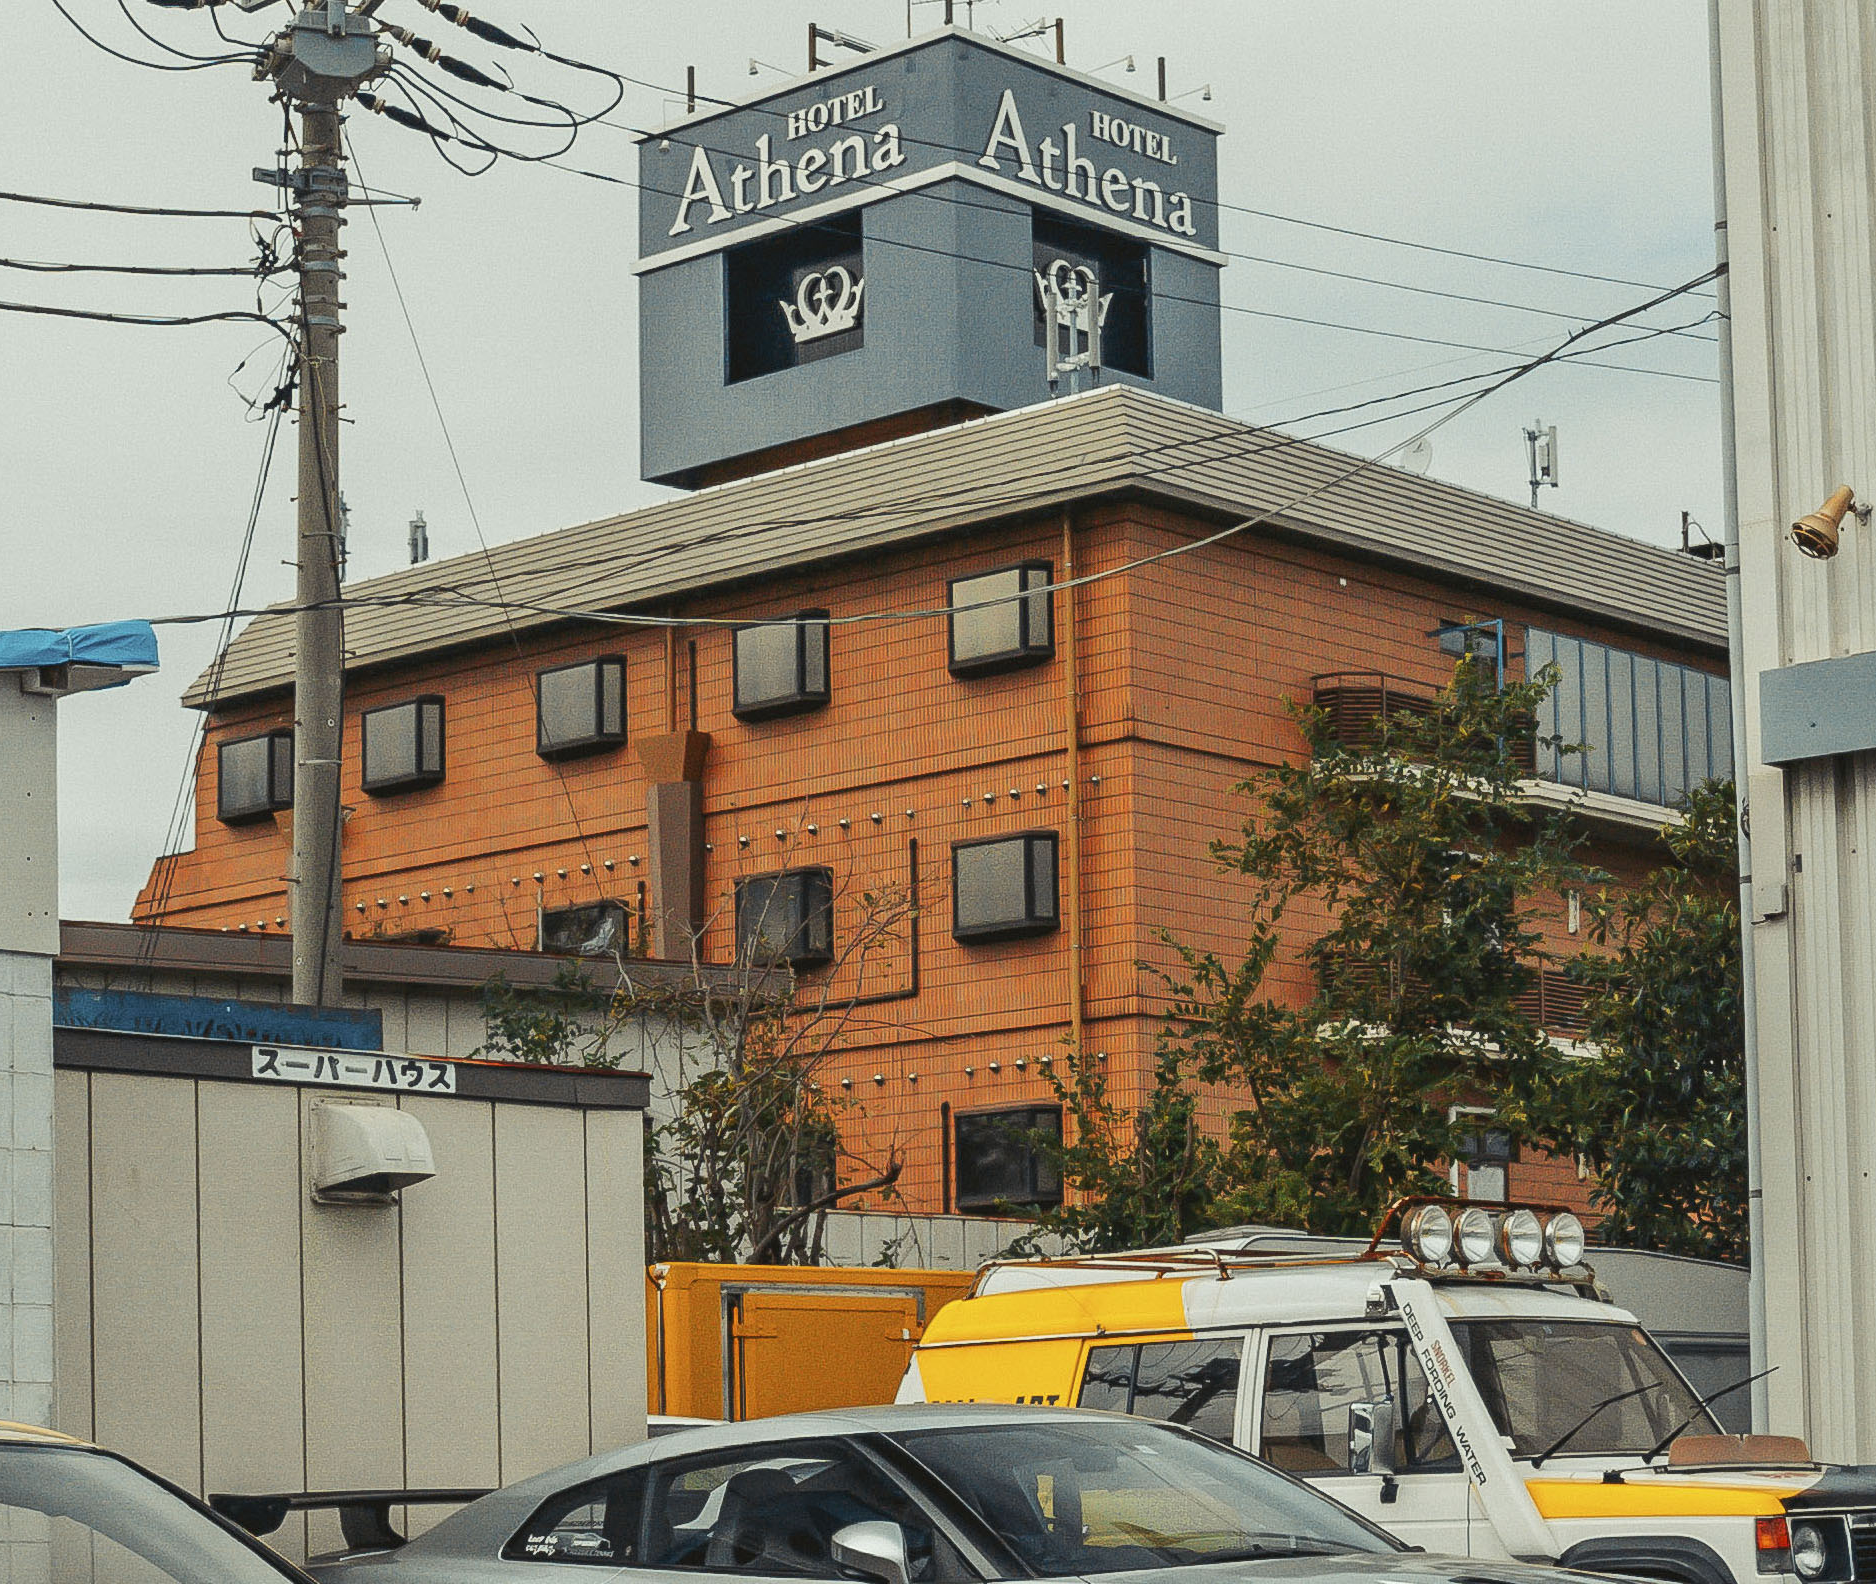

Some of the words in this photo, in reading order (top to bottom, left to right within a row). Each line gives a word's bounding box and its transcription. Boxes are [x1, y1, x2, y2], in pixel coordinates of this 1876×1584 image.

[787, 85, 883, 141] HOTEL
[1090, 110, 1177, 165] HOTEL
[669, 122, 906, 237] Athena
[978, 89, 1197, 237] Athena
[256, 1047, 453, 1090] スーパーハウス
[1430, 1340, 1456, 1389] SNORKEL
[1403, 1302, 1424, 1343] DEEP
[1421, 1348, 1457, 1420] FORDING
[1456, 1426, 1487, 1486] WATER
